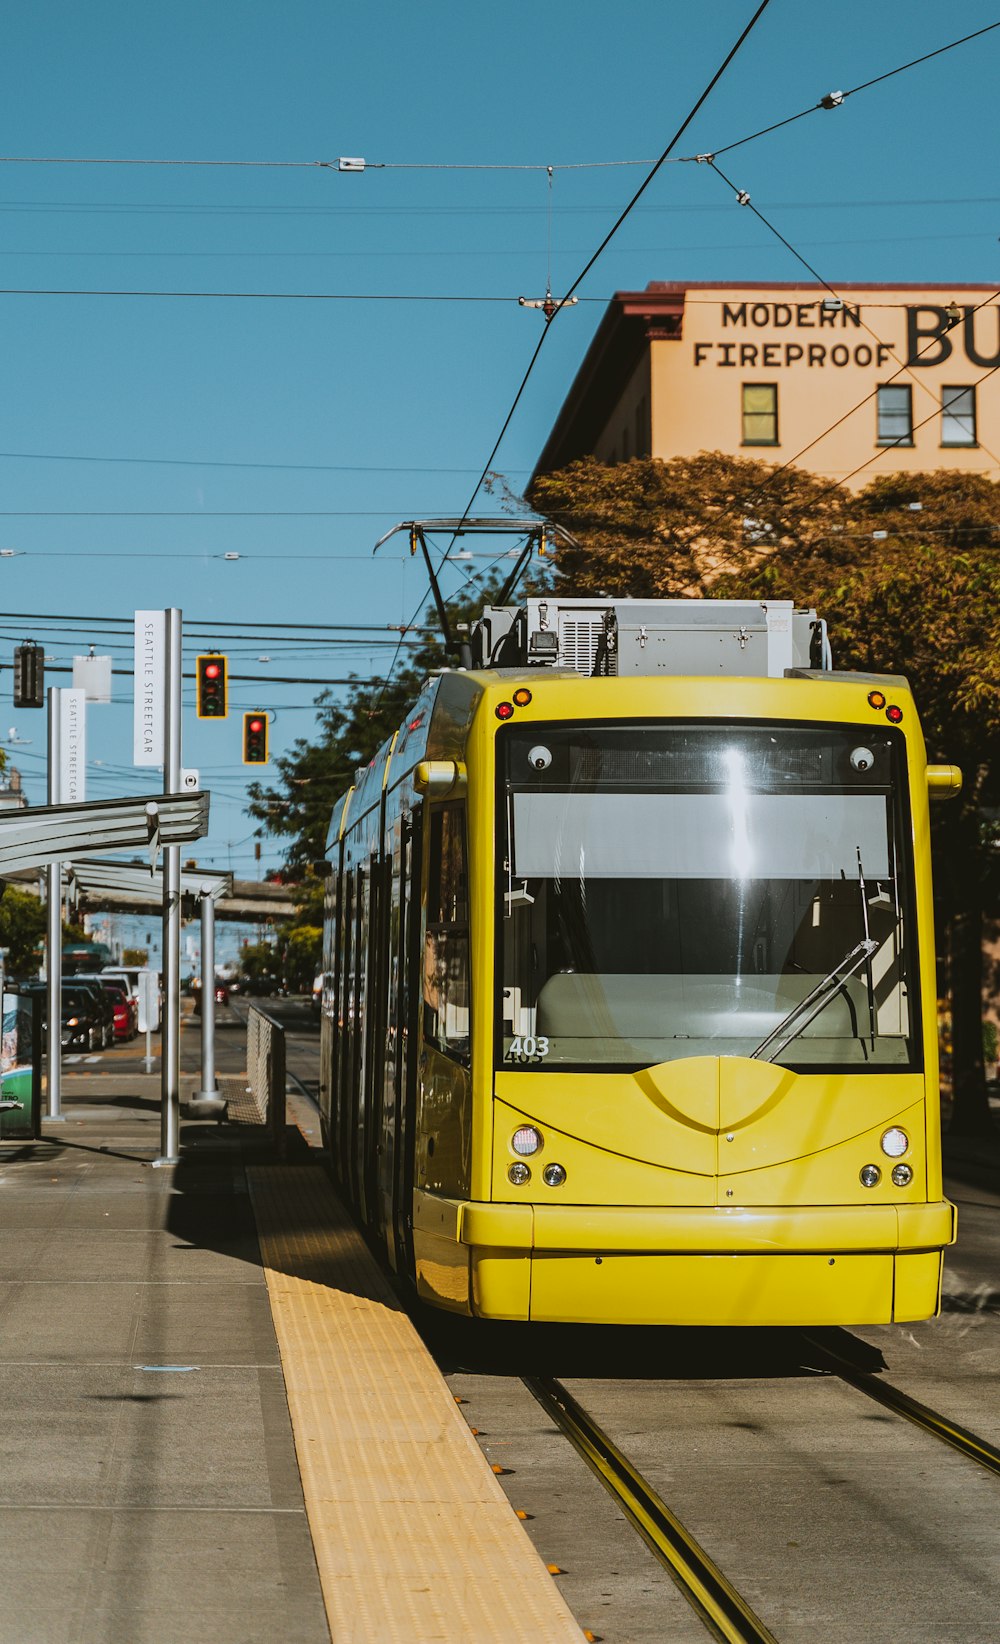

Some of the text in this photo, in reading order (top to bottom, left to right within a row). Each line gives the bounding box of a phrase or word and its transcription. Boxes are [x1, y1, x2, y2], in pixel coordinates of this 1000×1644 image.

[721, 302, 861, 328] MODERN
[905, 304, 1000, 368] BU
[693, 342, 896, 368] FIREPROOF
[143, 623, 154, 753] SEATTLE STREETCAR
[68, 698, 78, 801] SEATTLE STREETCAR
[509, 1036, 549, 1057] 403
